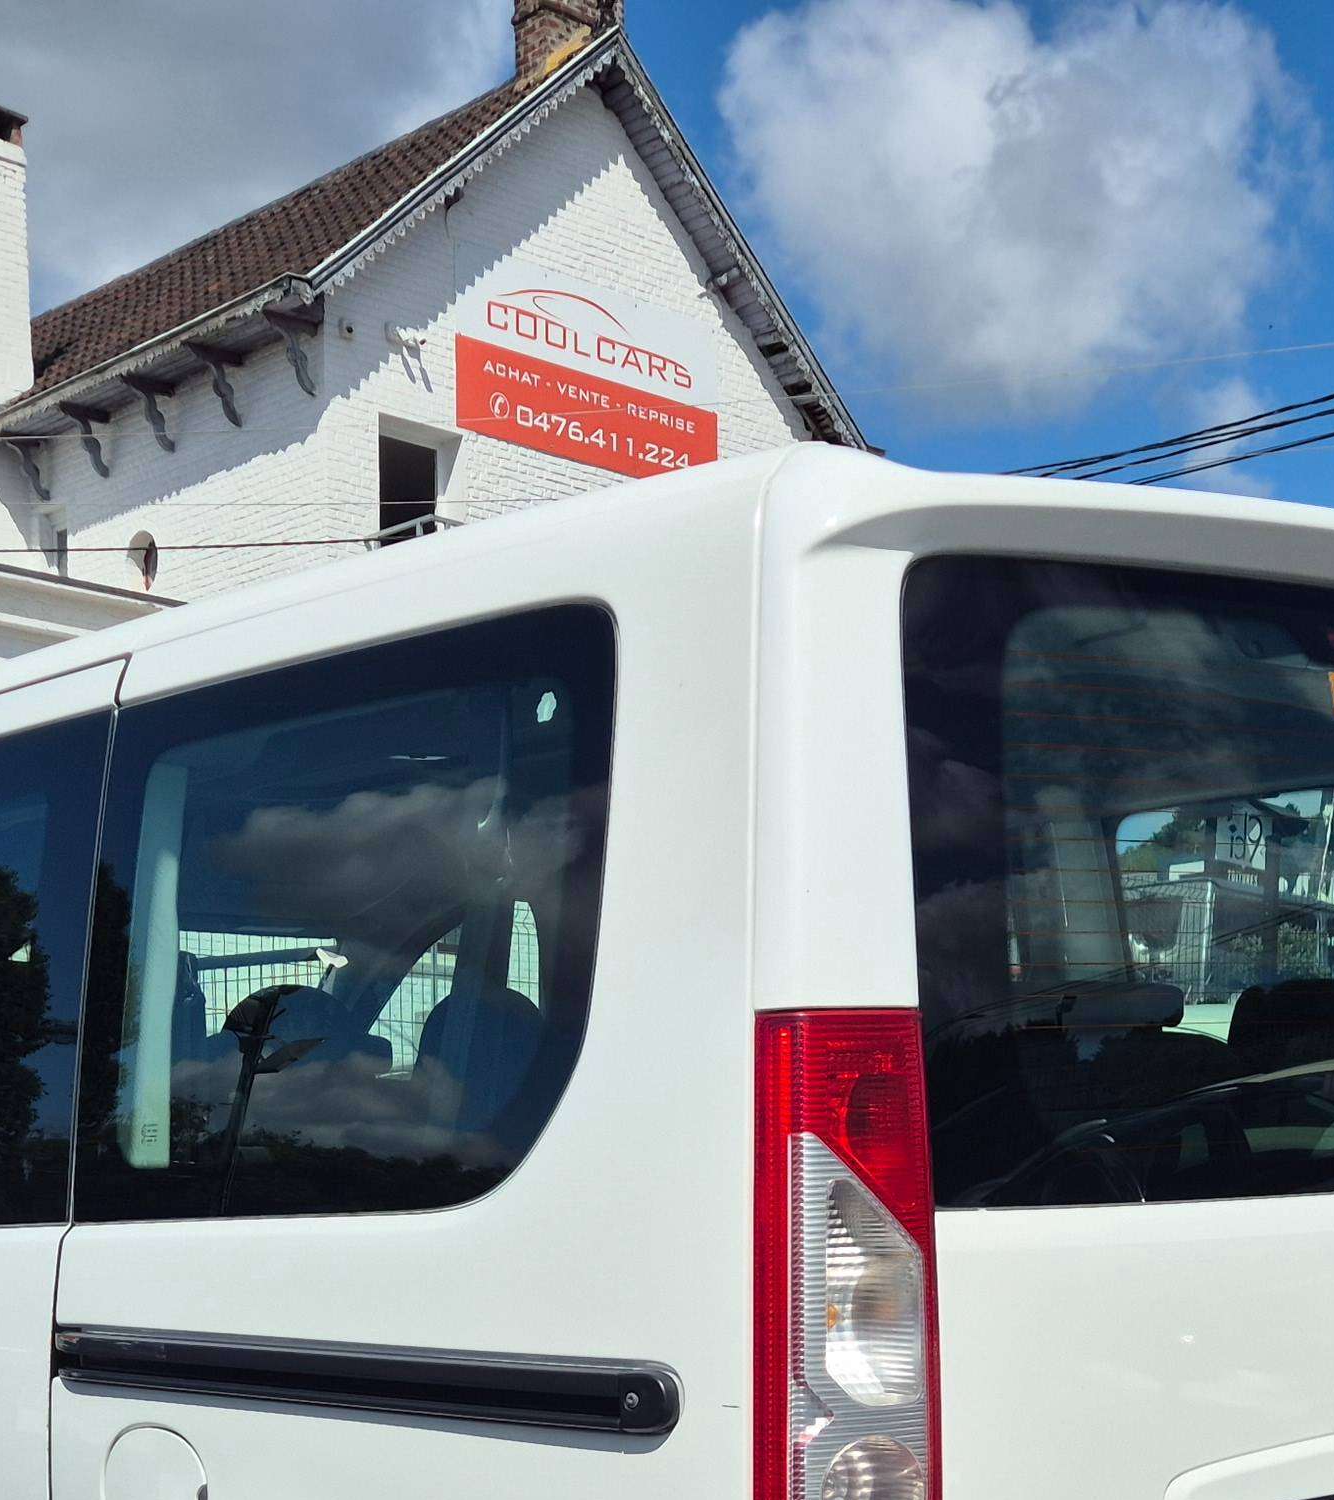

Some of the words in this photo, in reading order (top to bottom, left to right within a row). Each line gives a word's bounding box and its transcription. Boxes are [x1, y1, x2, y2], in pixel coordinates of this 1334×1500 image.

[487, 300, 692, 389] COOLCARS
[482, 359, 541, 388] ACHAT
[556, 380, 610, 409] VENTE
[626, 403, 696, 434] REPRISE
[516, 404, 691, 469] 0476.411.224
